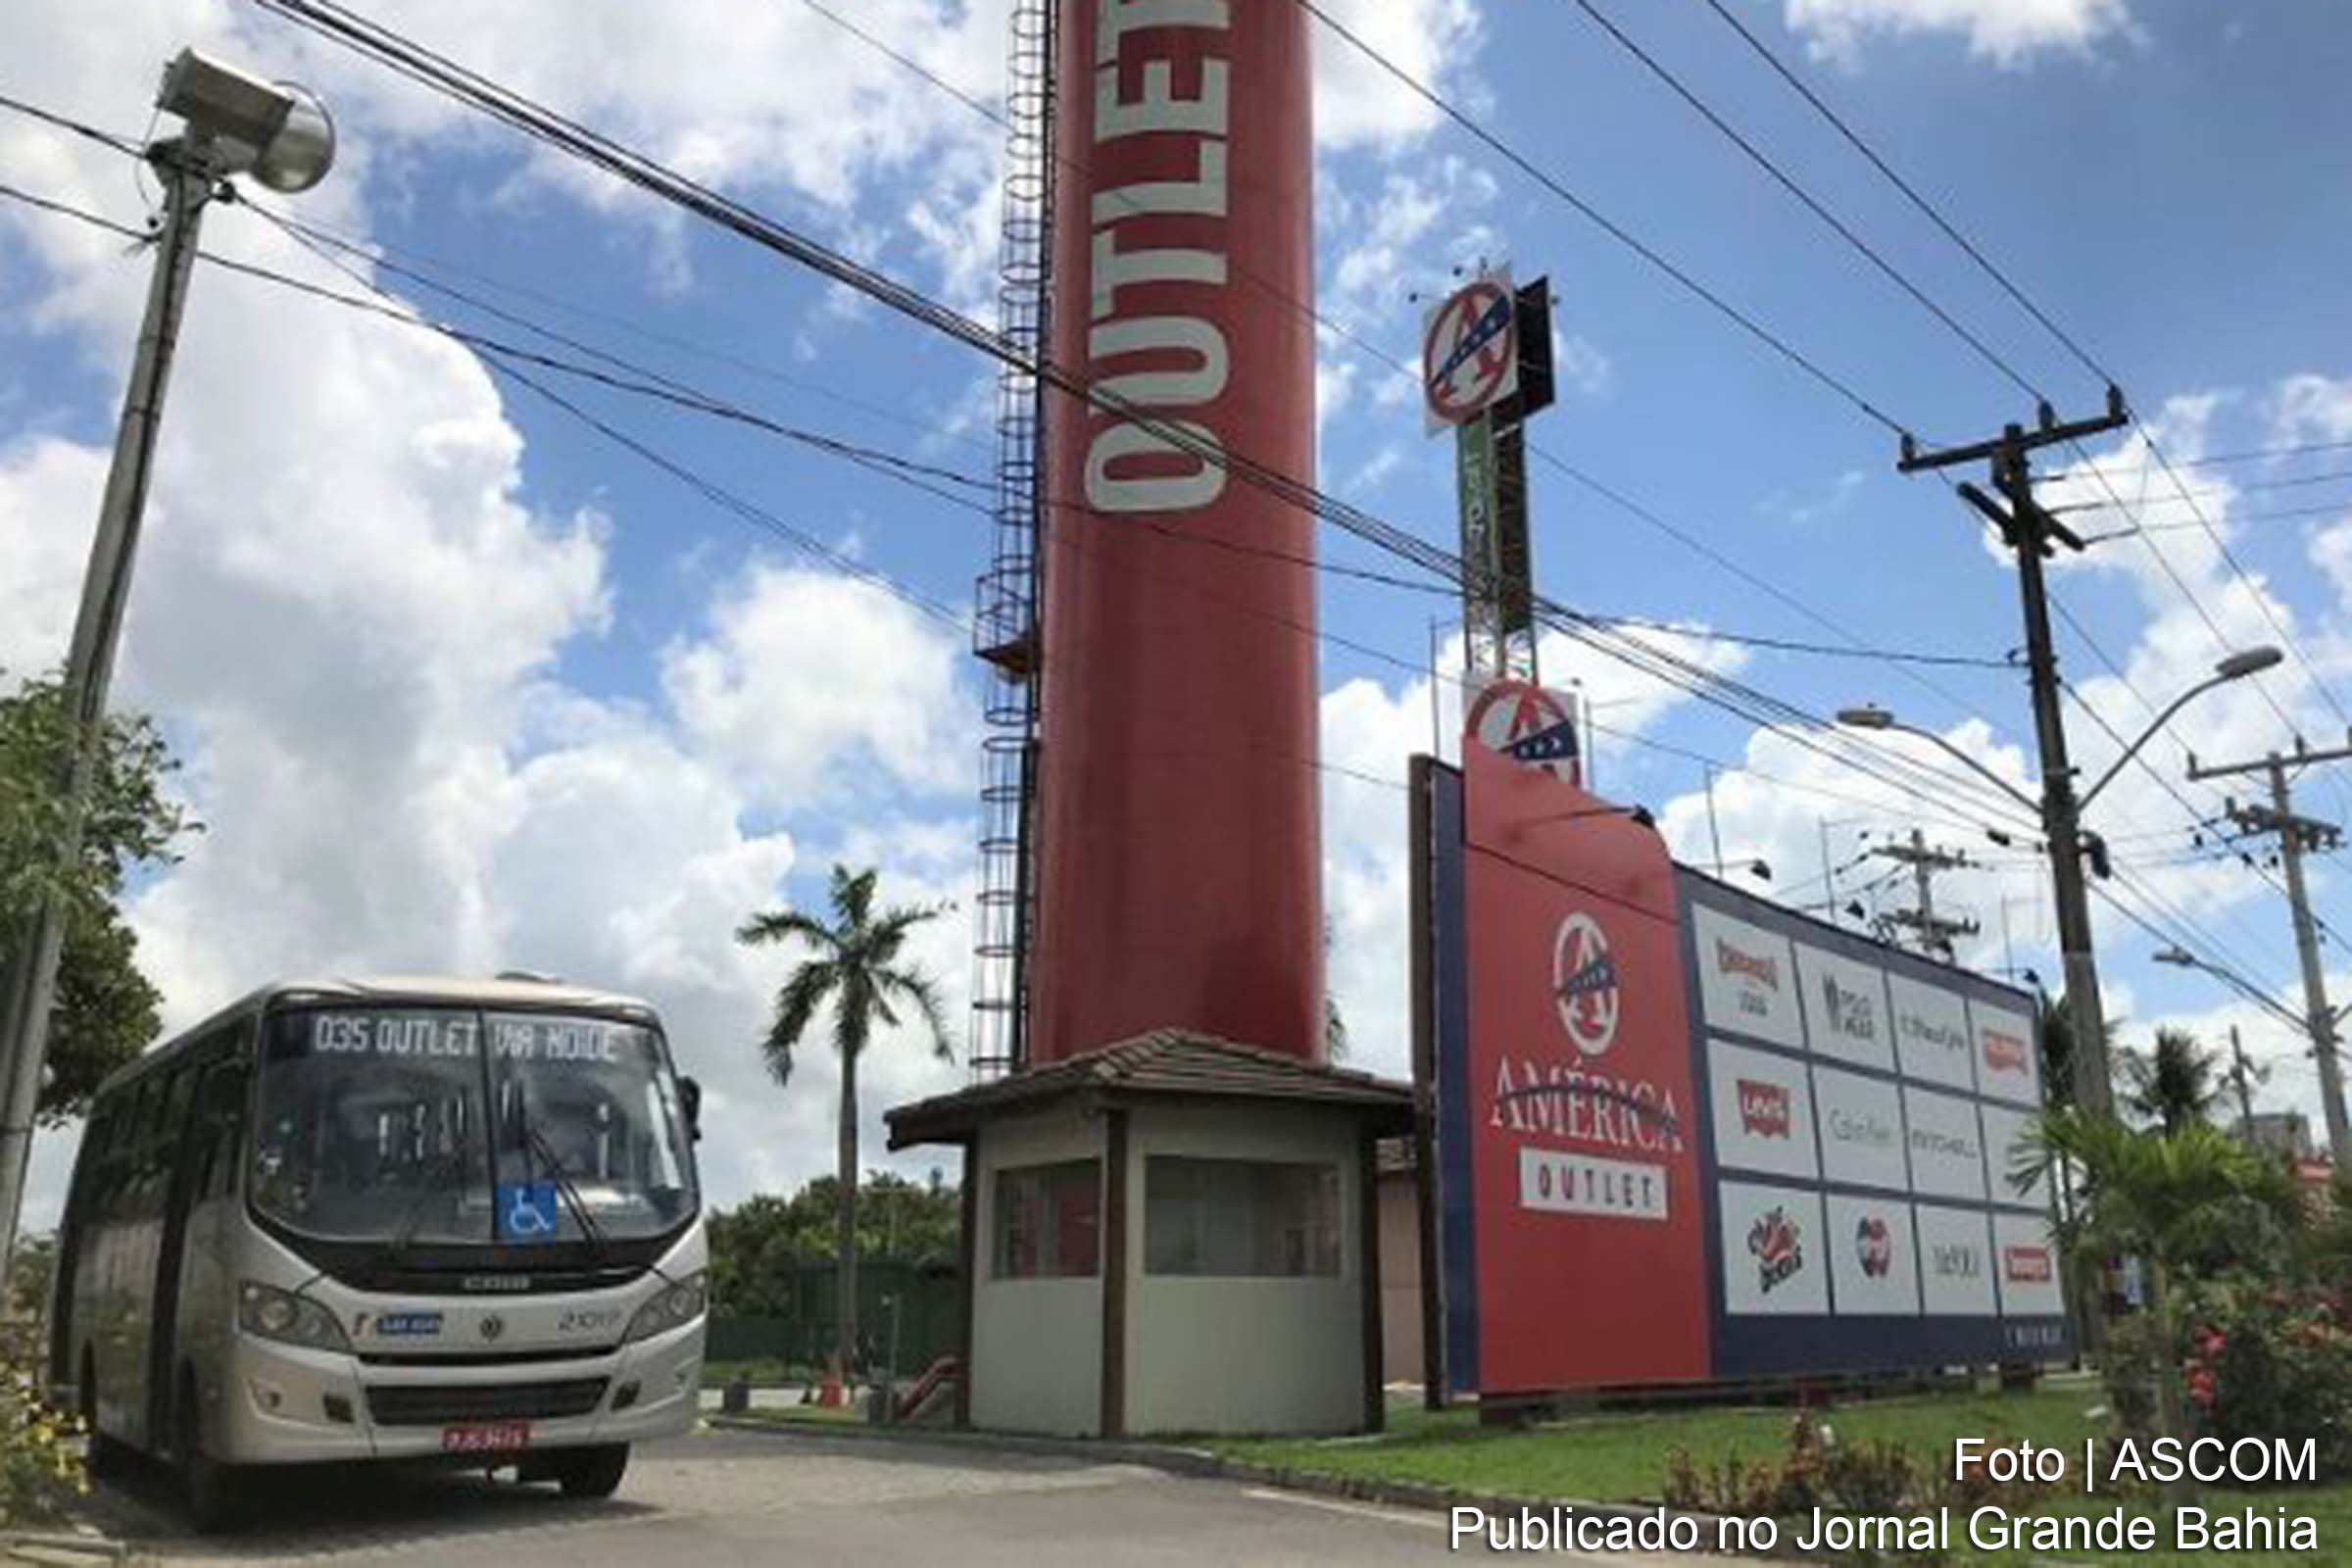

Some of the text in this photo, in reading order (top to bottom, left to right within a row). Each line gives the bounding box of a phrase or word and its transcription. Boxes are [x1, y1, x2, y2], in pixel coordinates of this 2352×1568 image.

[1084, 0, 1230, 512] OUTLET
[375, 1019, 478, 1056] OUTLET
[1489, 1054, 1684, 1153] AMÉRICA
[1538, 1163, 1654, 1208] OUTLET
